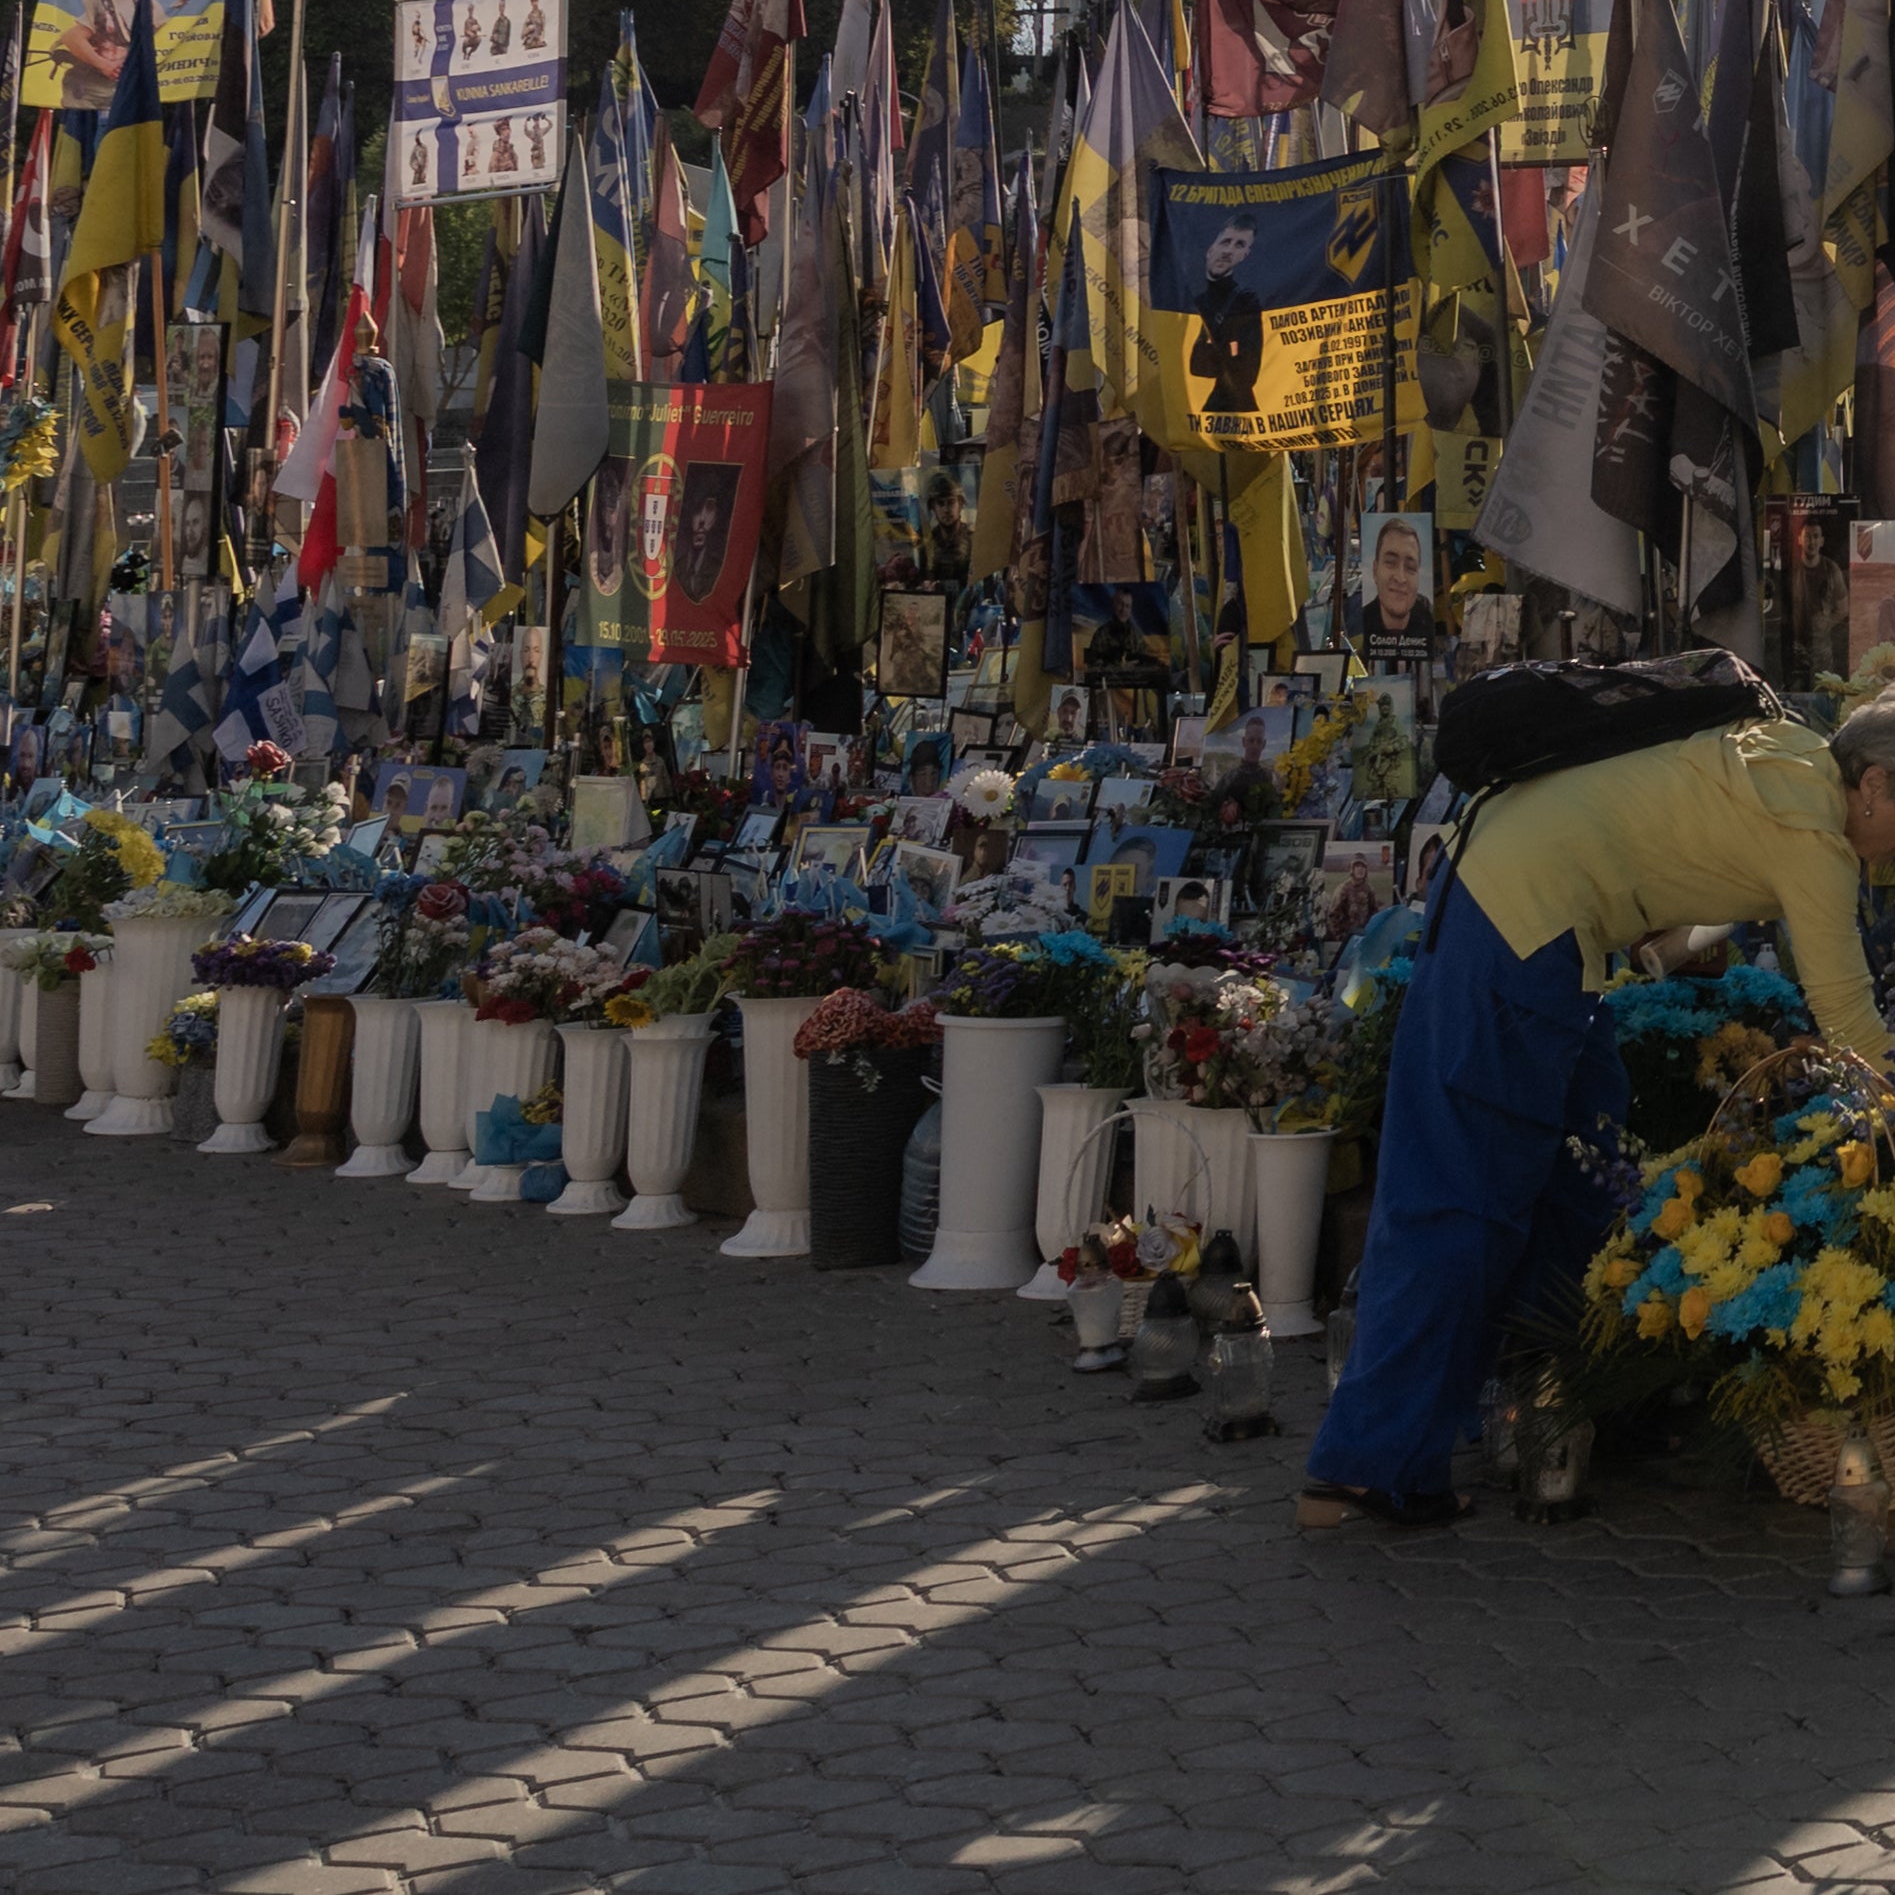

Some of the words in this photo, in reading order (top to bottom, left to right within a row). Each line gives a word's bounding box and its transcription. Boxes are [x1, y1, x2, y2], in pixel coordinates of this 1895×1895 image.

[1169, 184, 1185, 201] 12
[1185, 185, 1246, 208] БРИГАДА
[1270, 310, 1307, 330] ПАНОВ
[1310, 303, 1346, 322] АРТЕМ
[1647, 285, 1714, 334] ВІКТОР
[1280, 321, 1342, 346] ПОЗИВНИЙ
[1335, 353, 1354, 367] ПРИ
[1303, 368, 1351, 388] БОЙОВОГО
[693, 404, 755, 426] Guerreiro
[1186, 412, 1203, 434] ТИ
[1204, 410, 1255, 435] ЗАВЖДИ
[1256, 414, 1266, 432] В
[1267, 406, 1318, 432] НАШИХ
[1793, 496, 1831, 508] ГУДИМ
[1369, 634, 1399, 647] Солоп
[1399, 635, 1428, 648] Денис
[266, 696, 294, 750] SASHKO
